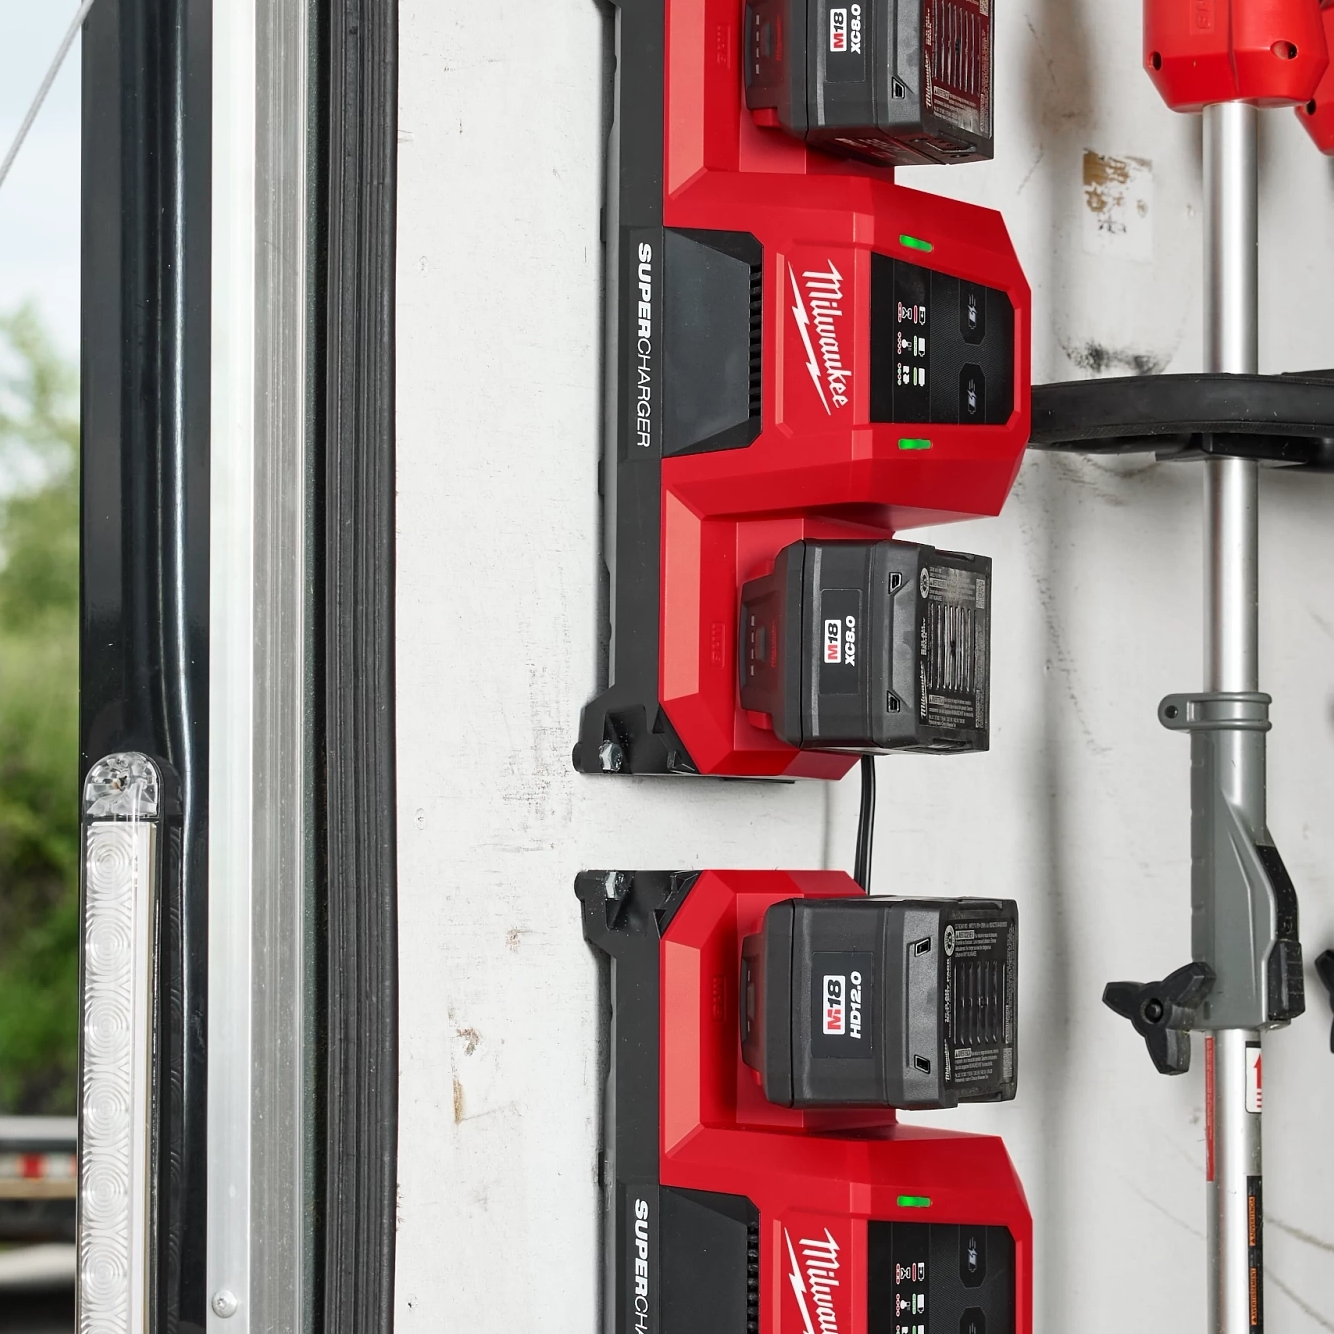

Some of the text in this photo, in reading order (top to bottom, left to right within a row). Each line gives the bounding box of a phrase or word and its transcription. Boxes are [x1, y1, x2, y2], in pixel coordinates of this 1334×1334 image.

[833, 11, 844, 49] M18
[850, 3, 861, 55] XC8.0
[637, 242, 652, 448] SUPERCHARGER
[801, 258, 850, 409] Milwaukee
[827, 622, 838, 660] M18
[845, 615, 856, 667] XC8.0
[827, 979, 841, 1030] M18
[849, 970, 862, 1040] HD12.0
